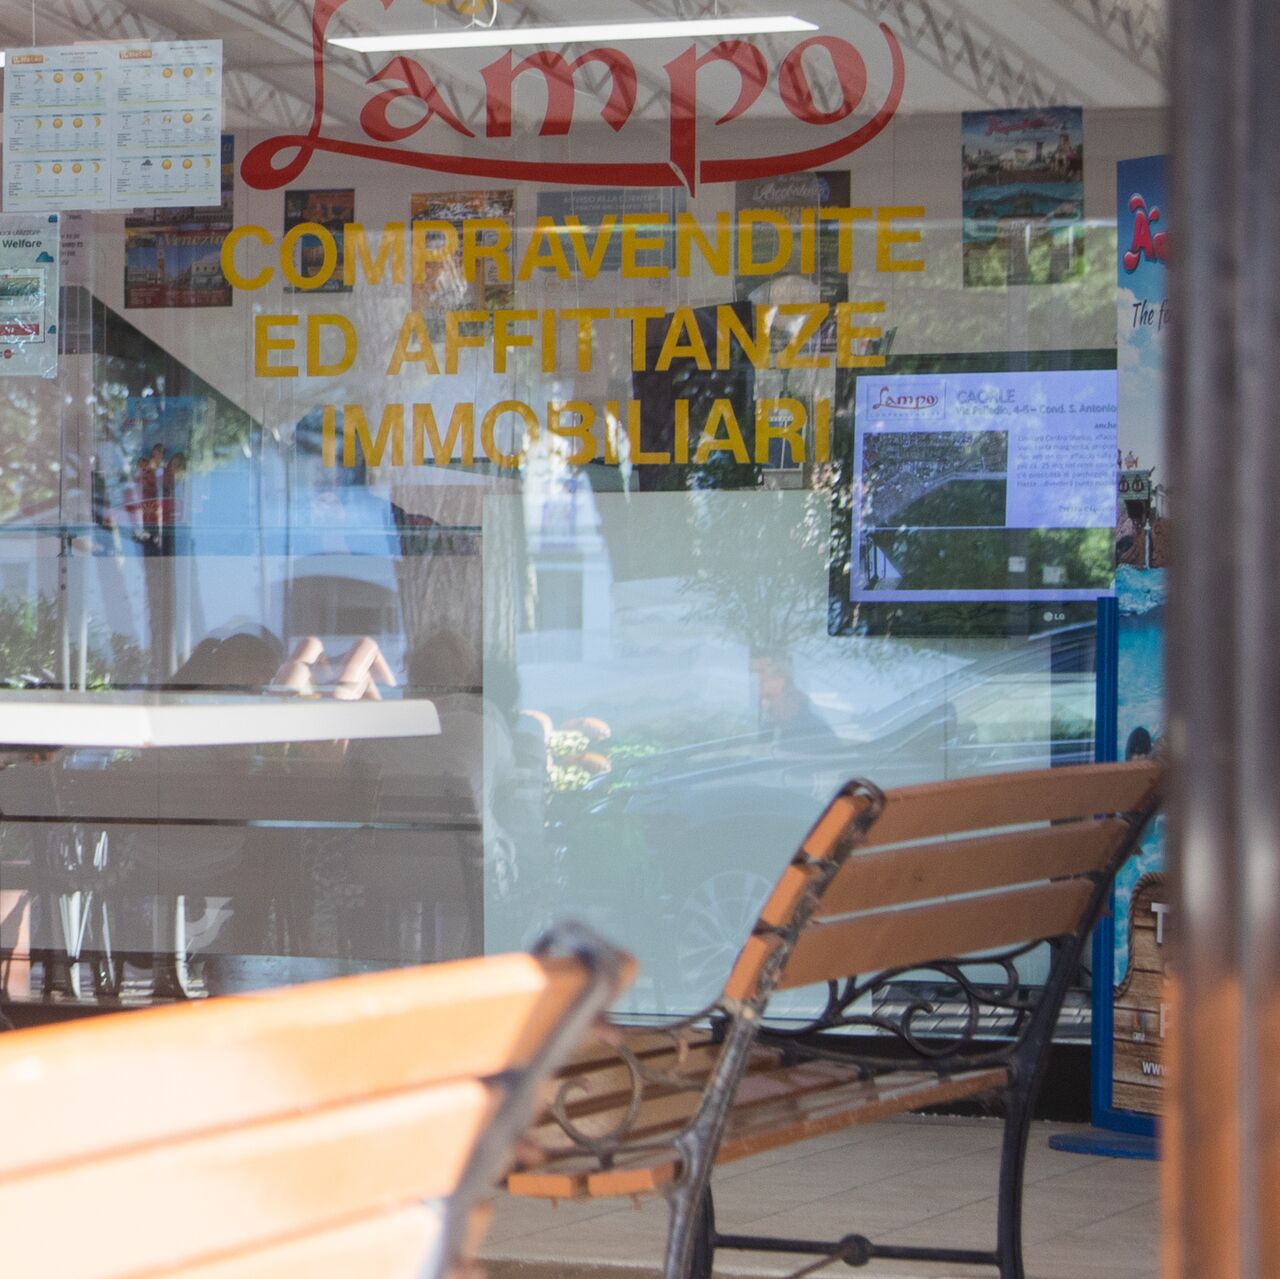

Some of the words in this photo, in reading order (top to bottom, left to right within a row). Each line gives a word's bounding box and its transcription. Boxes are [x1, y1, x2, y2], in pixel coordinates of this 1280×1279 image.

[2, 238, 43, 249] Welfare
[220, 205, 926, 291] COMPRAVENDITE
[1132, 299, 1154, 329] The
[254, 313, 358, 378] ED
[386, 300, 887, 377] AFFITTANZE
[872, 385, 939, 411] Lampo
[1079, 402, 1117, 413] Antonio
[321, 397, 831, 469] IMMOBILIARI
